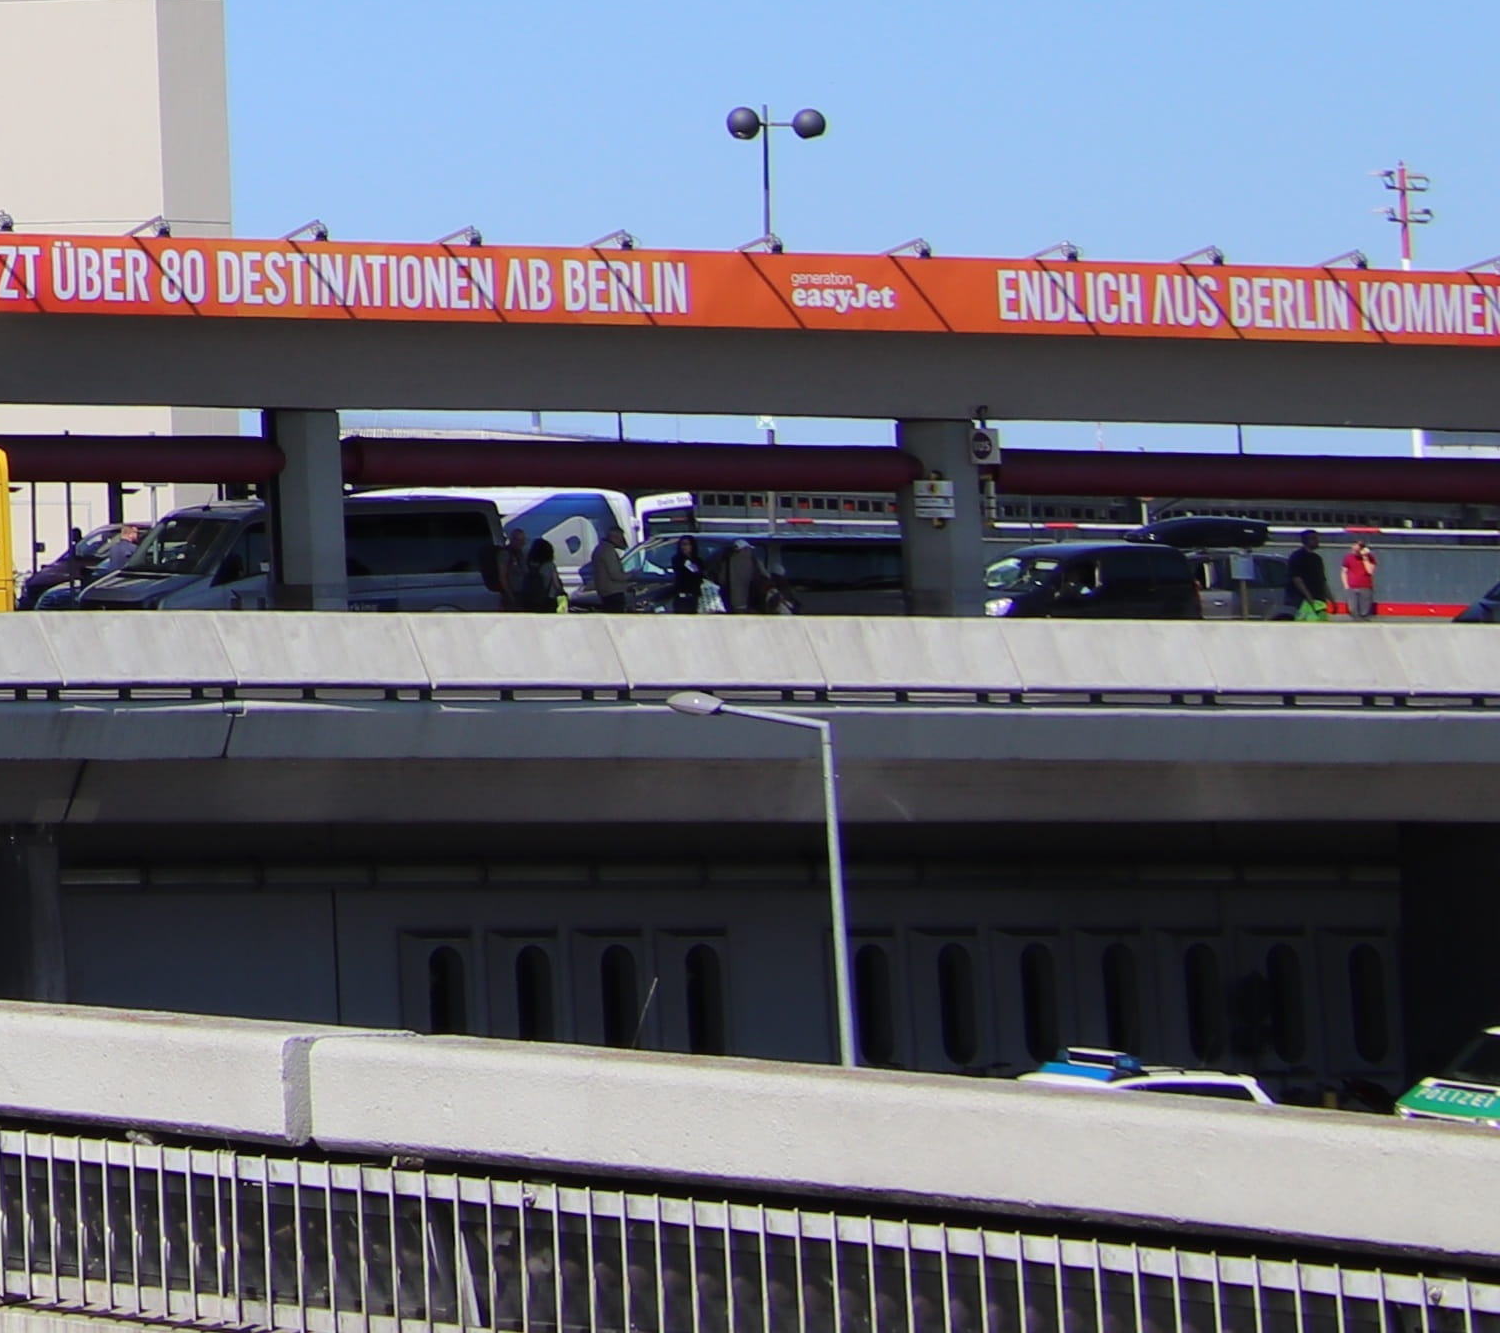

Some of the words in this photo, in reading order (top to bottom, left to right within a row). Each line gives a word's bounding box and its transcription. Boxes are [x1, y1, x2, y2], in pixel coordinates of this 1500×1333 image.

[50, 239, 150, 302] ÜBER
[159, 248, 204, 305] 80
[216, 250, 494, 310] DESTINATIONEN
[503, 258, 552, 312] AB
[562, 259, 688, 314] BERLIN
[790, 271, 853, 288] generation
[790, 281, 895, 314] easyJet
[996, 268, 1142, 326] ENDLICH
[1151, 273, 1220, 328] AUS
[1228, 277, 1348, 332] BERLIN
[1412, 1086, 1497, 1109] POLIZEI
